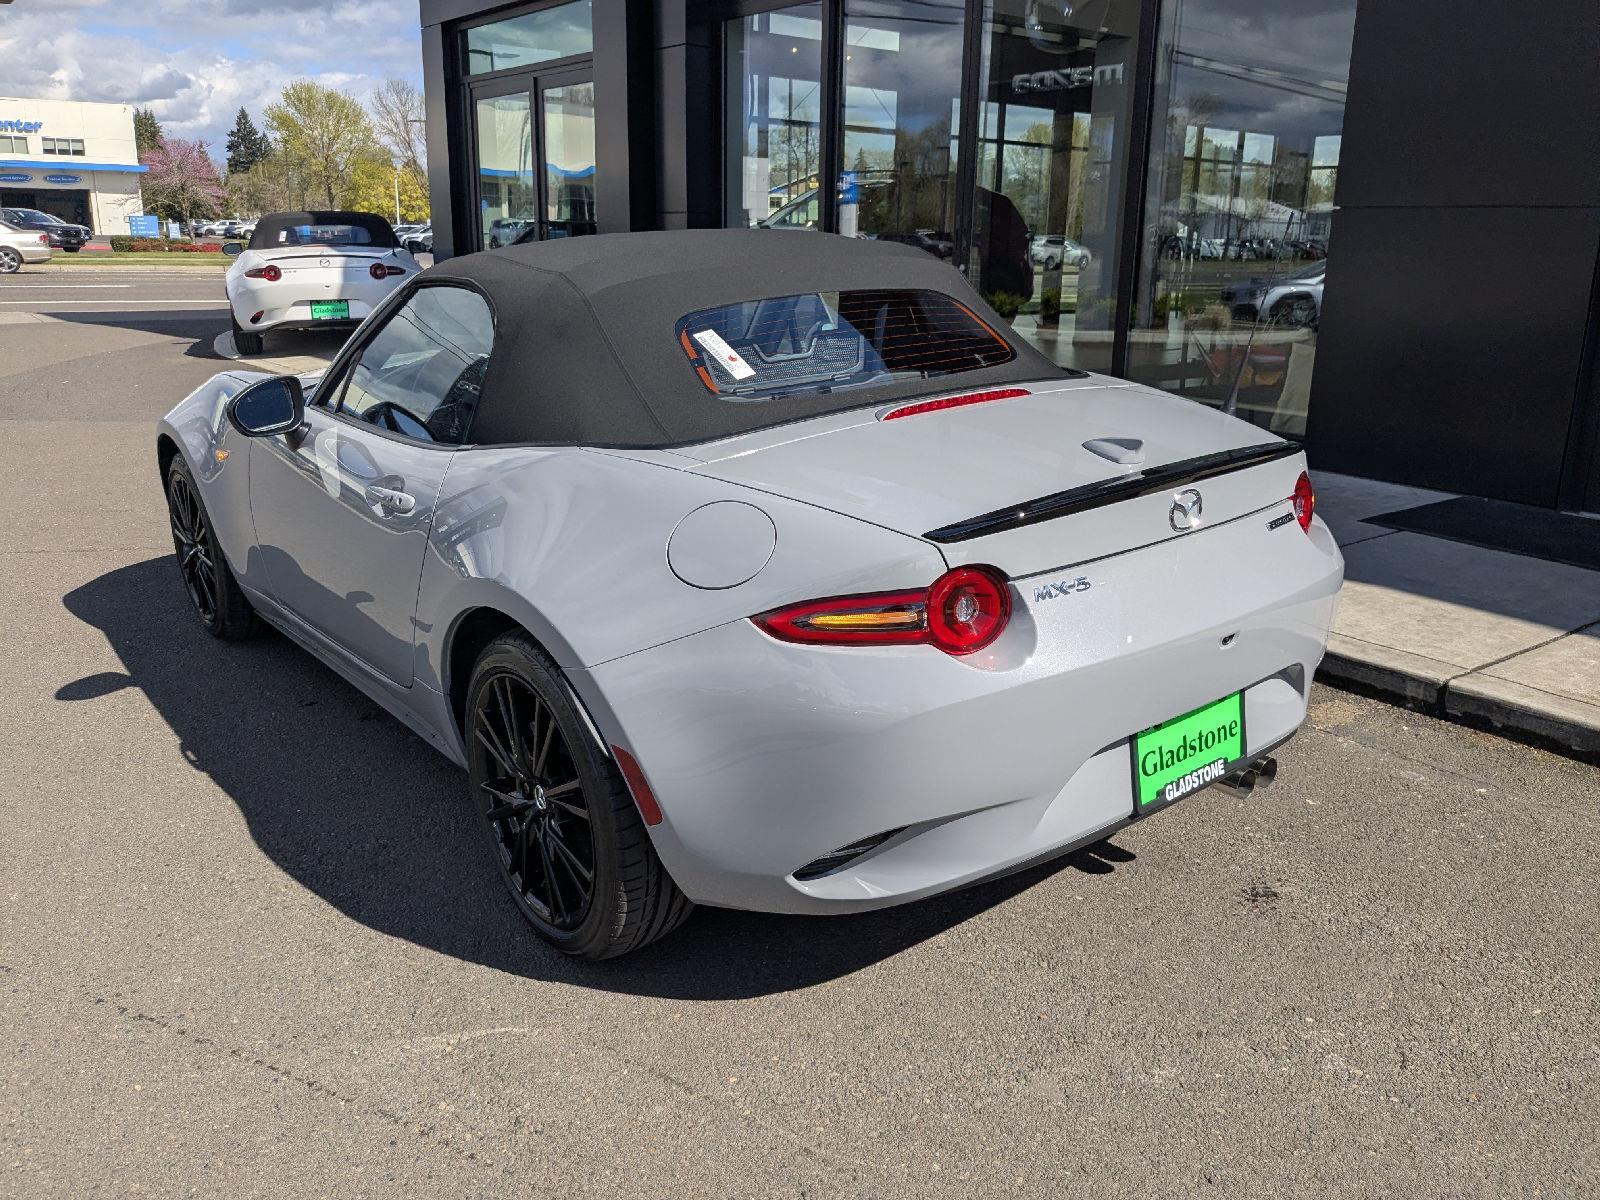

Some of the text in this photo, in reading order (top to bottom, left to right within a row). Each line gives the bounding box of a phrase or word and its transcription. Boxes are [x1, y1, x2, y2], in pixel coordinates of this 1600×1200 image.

[1033, 576, 1091, 602] MX-5
[1141, 719, 1239, 777] Gladstone
[1165, 759, 1225, 800] GLADSTONE
